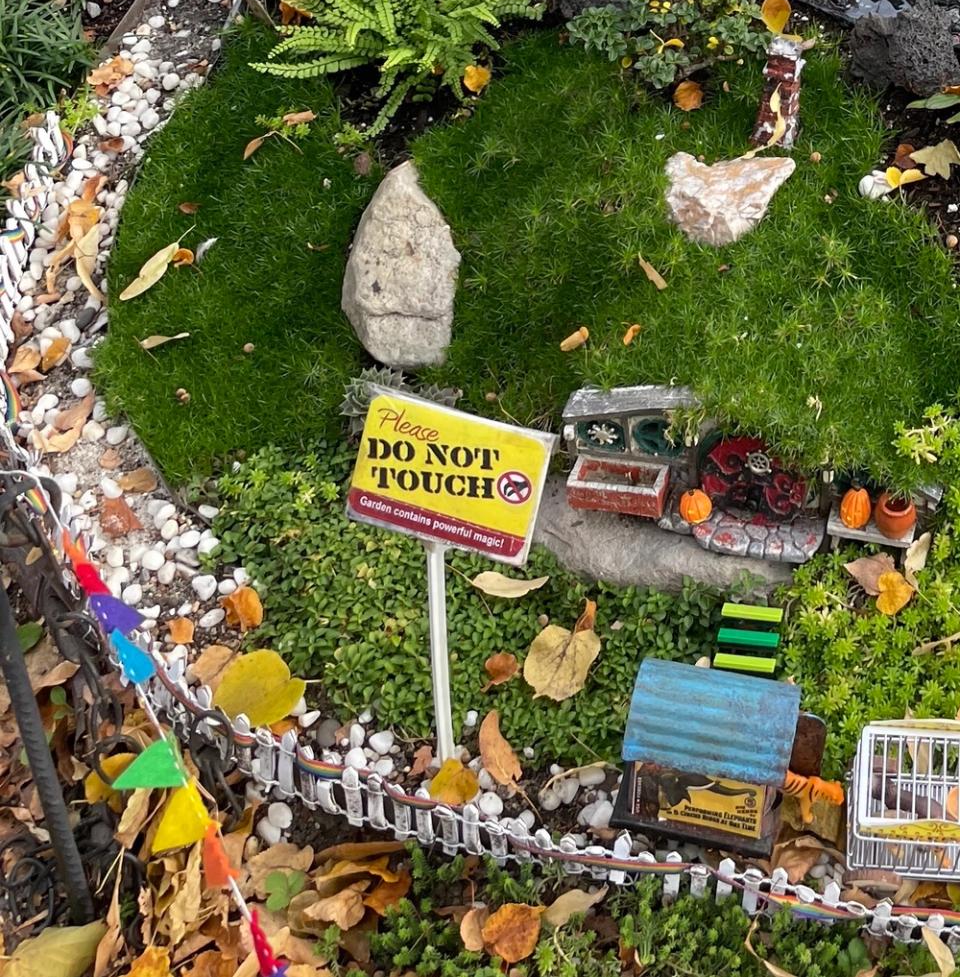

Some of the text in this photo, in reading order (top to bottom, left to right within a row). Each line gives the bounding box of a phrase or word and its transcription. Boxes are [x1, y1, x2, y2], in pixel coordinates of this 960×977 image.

[377, 407, 440, 442] Please
[367, 437, 500, 470] DO NOT
[371, 466, 496, 500] TOUCH
[359, 495, 505, 549] Garden contains powerful magic!
[684, 804, 757, 825] PERFORMING ELEPHANTS
[742, 822, 756, 832] TIME
